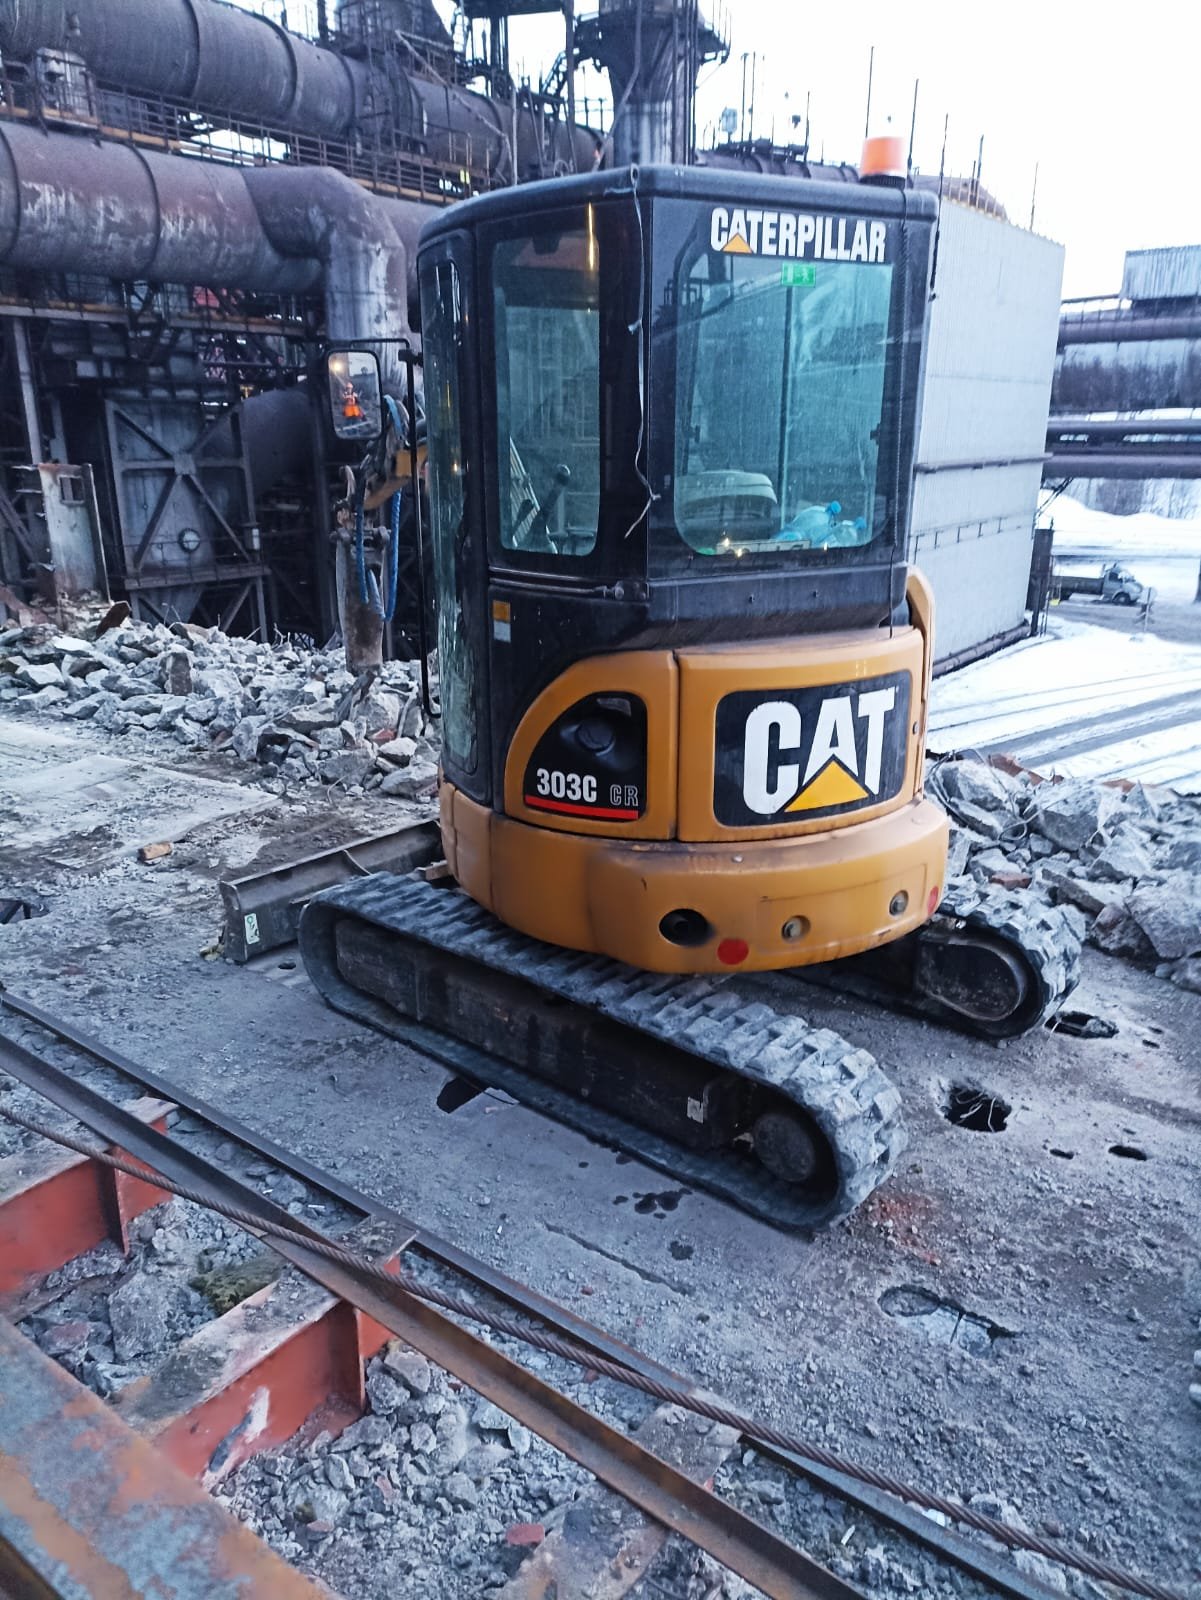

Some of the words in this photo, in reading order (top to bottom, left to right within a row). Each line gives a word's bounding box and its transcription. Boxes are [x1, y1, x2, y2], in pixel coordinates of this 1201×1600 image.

[710, 207, 887, 263] CATERPILLAR
[743, 686, 896, 816] CAT
[536, 767, 598, 803] 303C
[609, 784, 639, 807] CR
